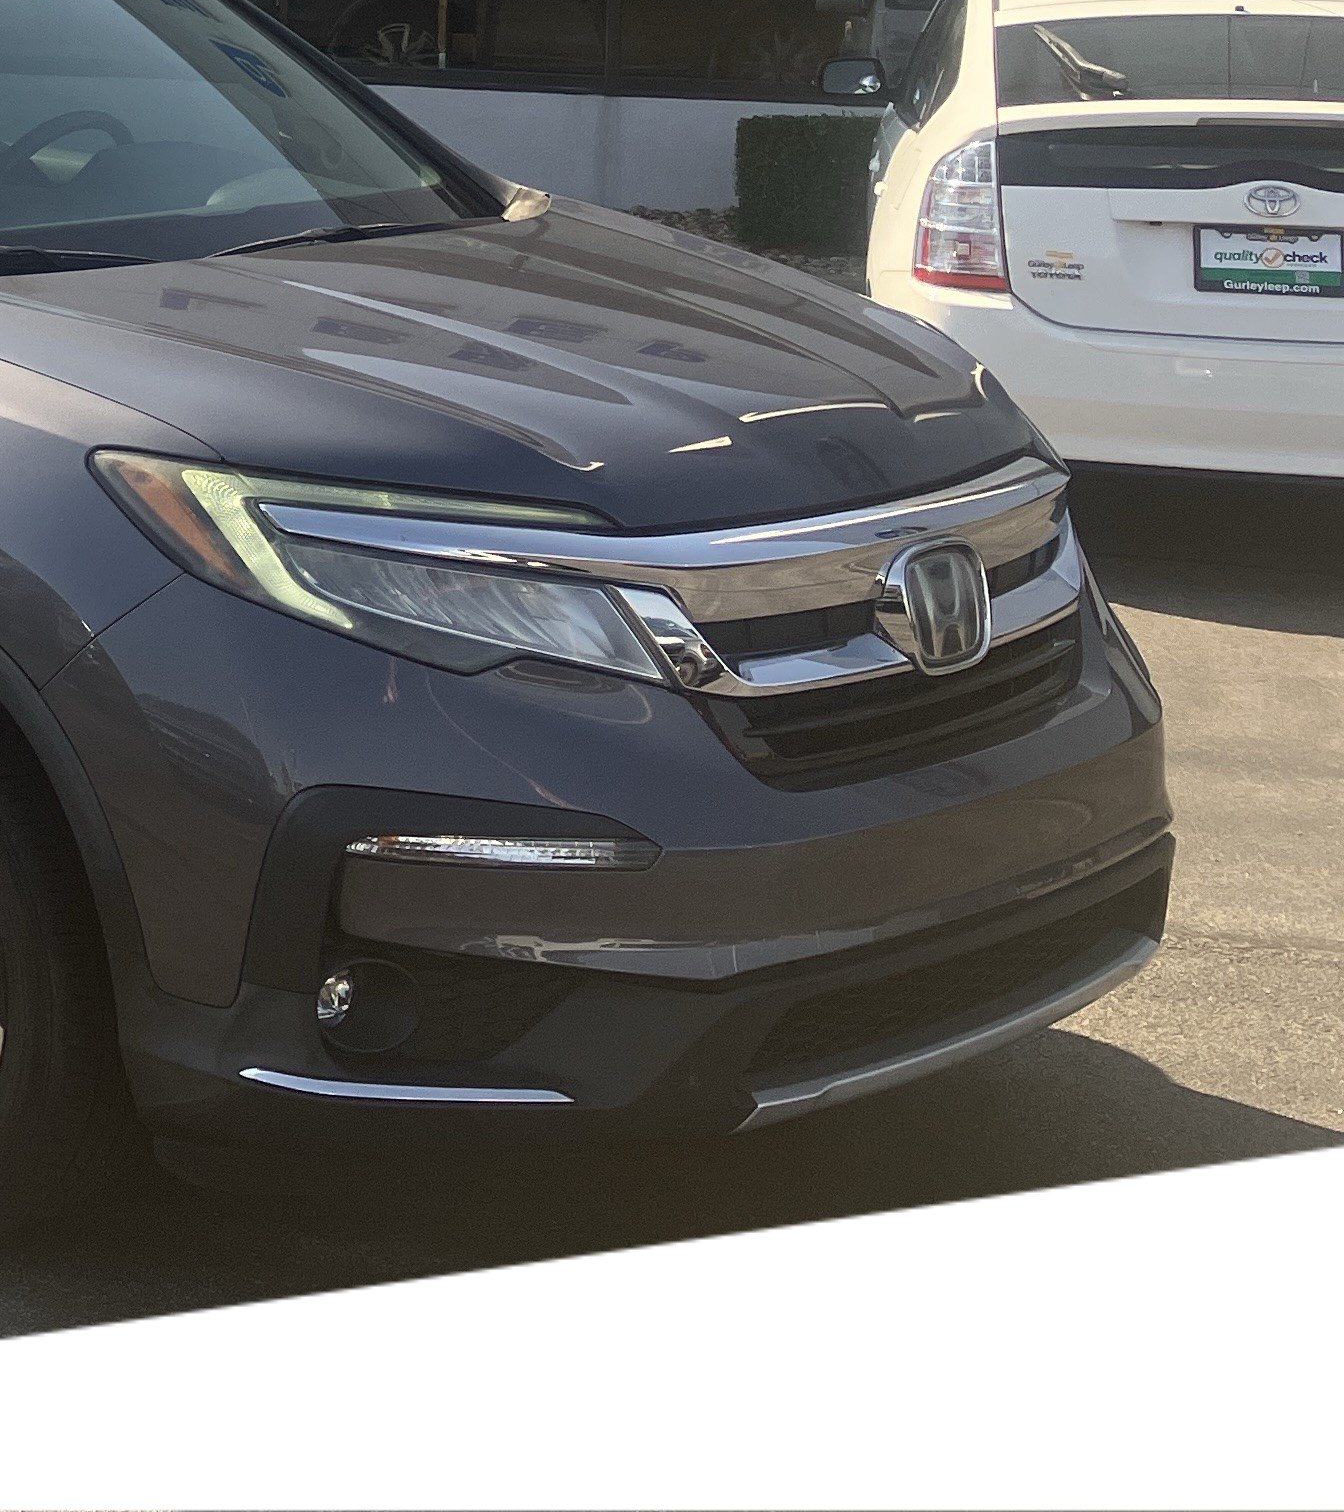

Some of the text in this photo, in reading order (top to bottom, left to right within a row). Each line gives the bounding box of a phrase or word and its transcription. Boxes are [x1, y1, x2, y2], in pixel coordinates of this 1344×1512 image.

[1214, 249, 1328, 264] quality check
[1223, 279, 1320, 294] Gurleyleep.com
